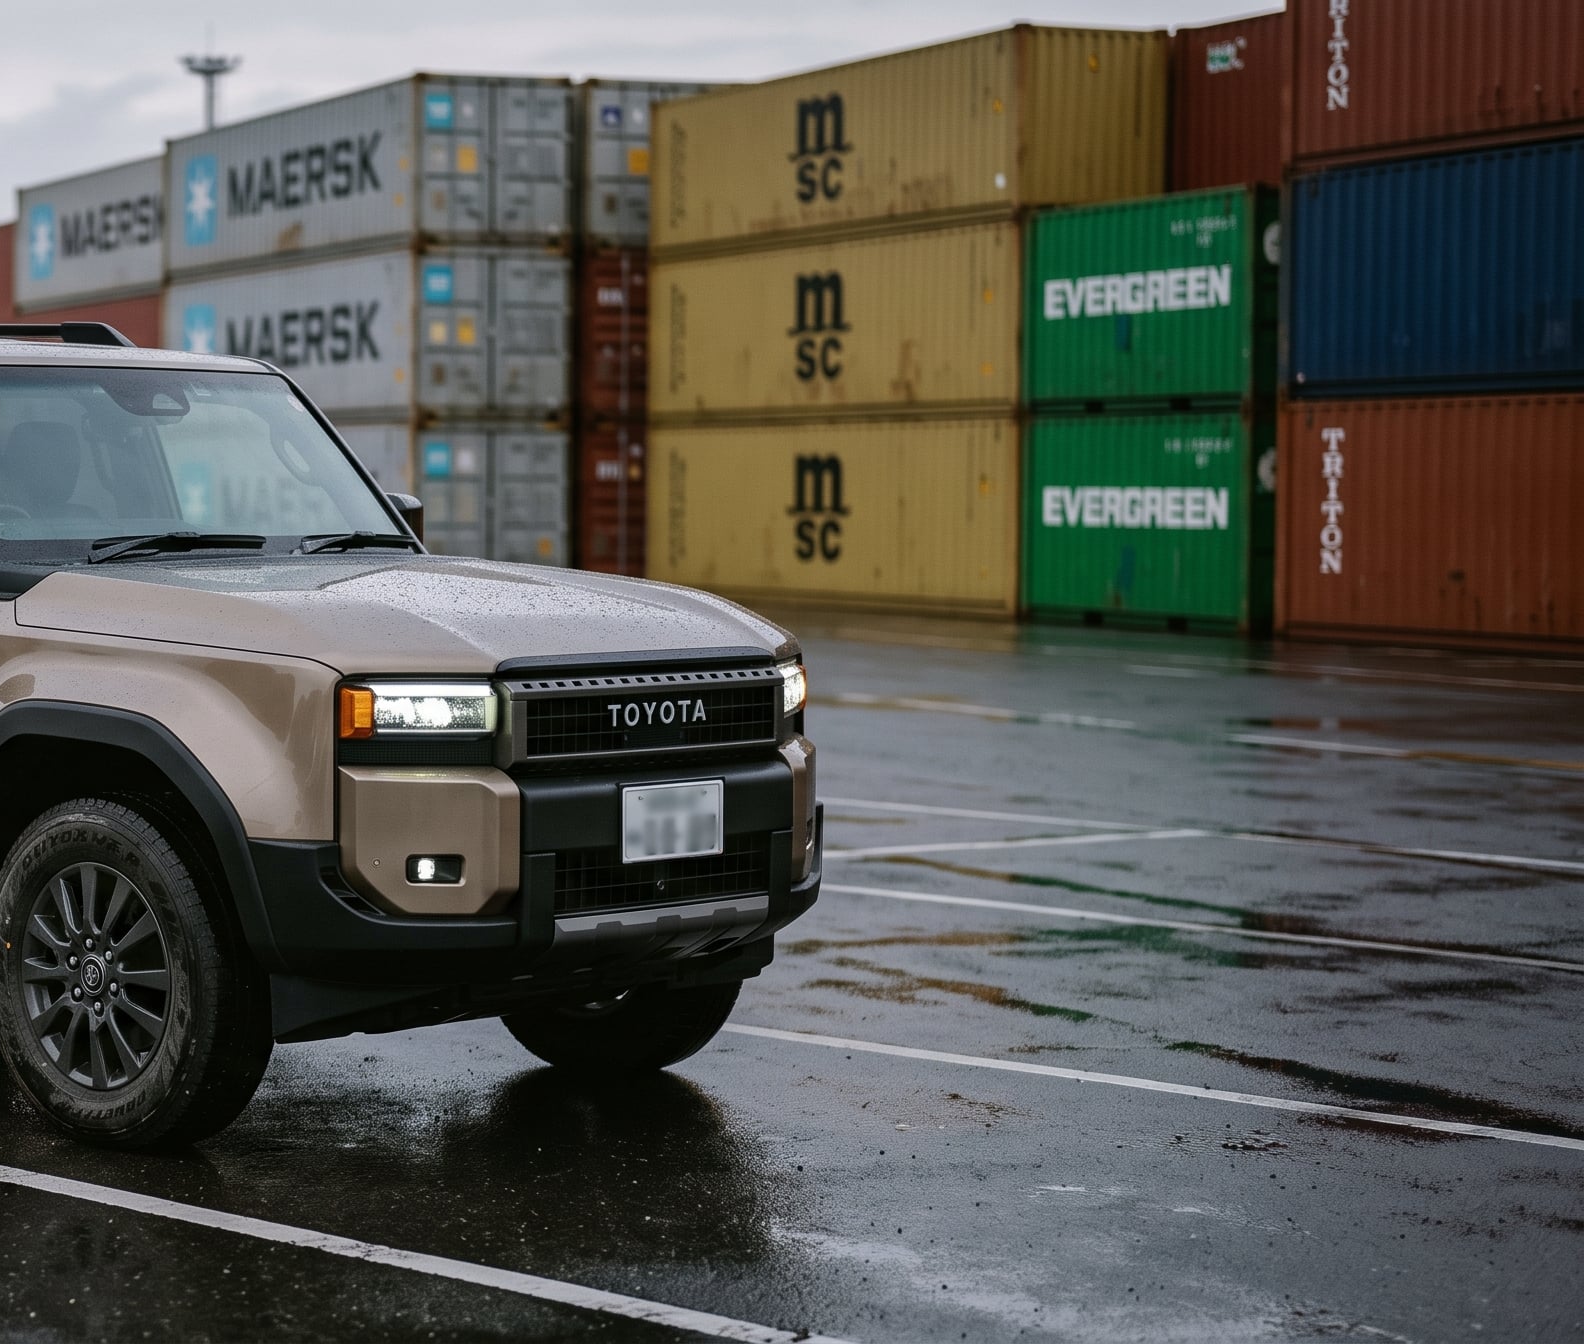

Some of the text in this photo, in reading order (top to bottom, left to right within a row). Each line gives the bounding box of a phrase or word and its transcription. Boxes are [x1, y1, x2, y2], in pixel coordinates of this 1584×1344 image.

[227, 131, 381, 217] MAERSK
[1043, 264, 1231, 320] EVERGREEN
[1042, 486, 1229, 530] EVERGREEN
[1320, 427, 1345, 574] TRITON
[608, 699, 706, 727] TOYOTA
